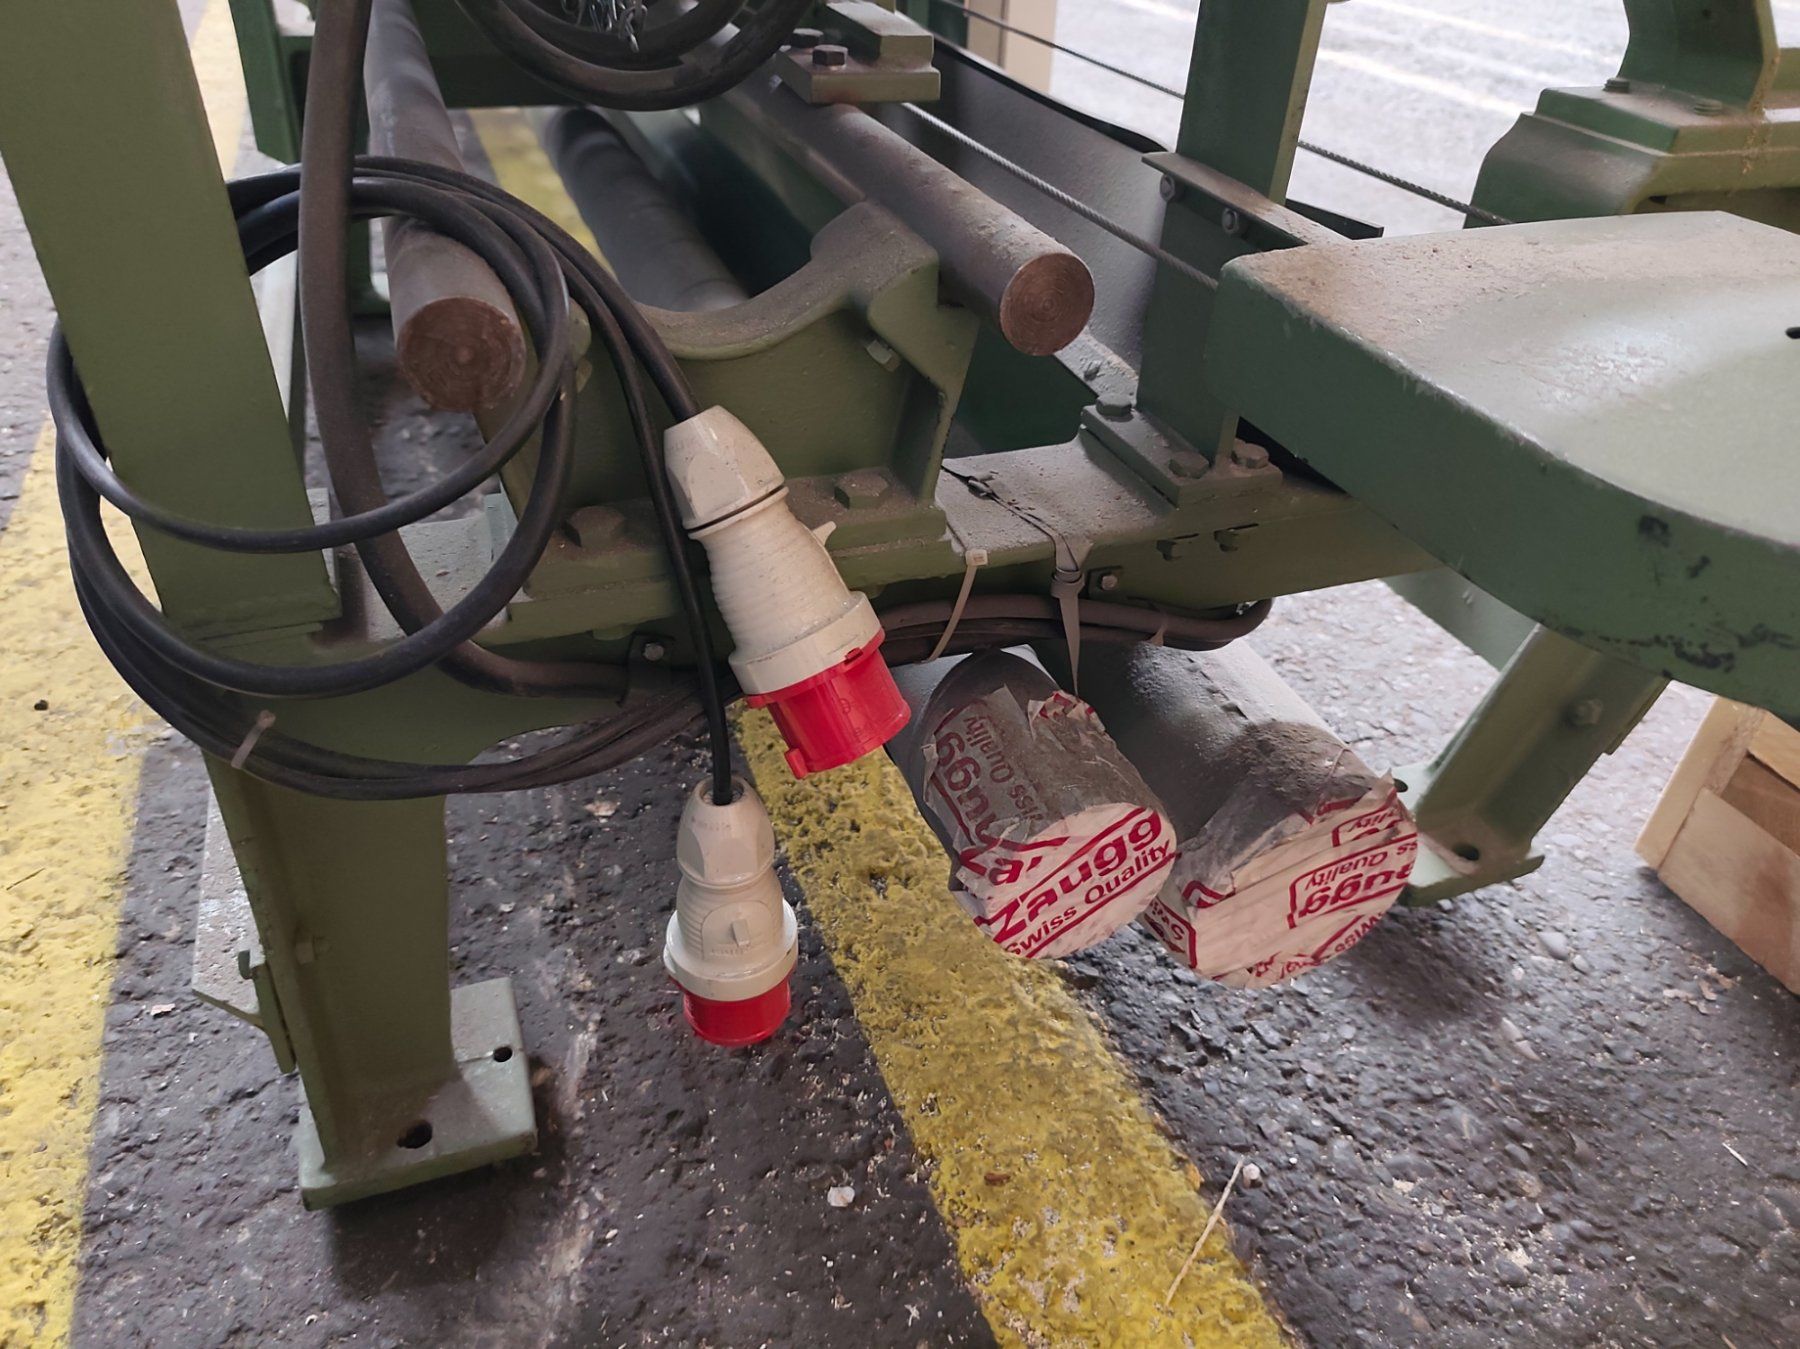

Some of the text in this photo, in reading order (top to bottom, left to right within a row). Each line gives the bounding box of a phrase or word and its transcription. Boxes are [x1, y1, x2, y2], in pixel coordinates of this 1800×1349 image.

[975, 810, 1162, 943] Zaugg
[1006, 905, 1077, 955] Swiss
[1084, 840, 1170, 904] Quality
[1304, 851, 1388, 890] Quality
